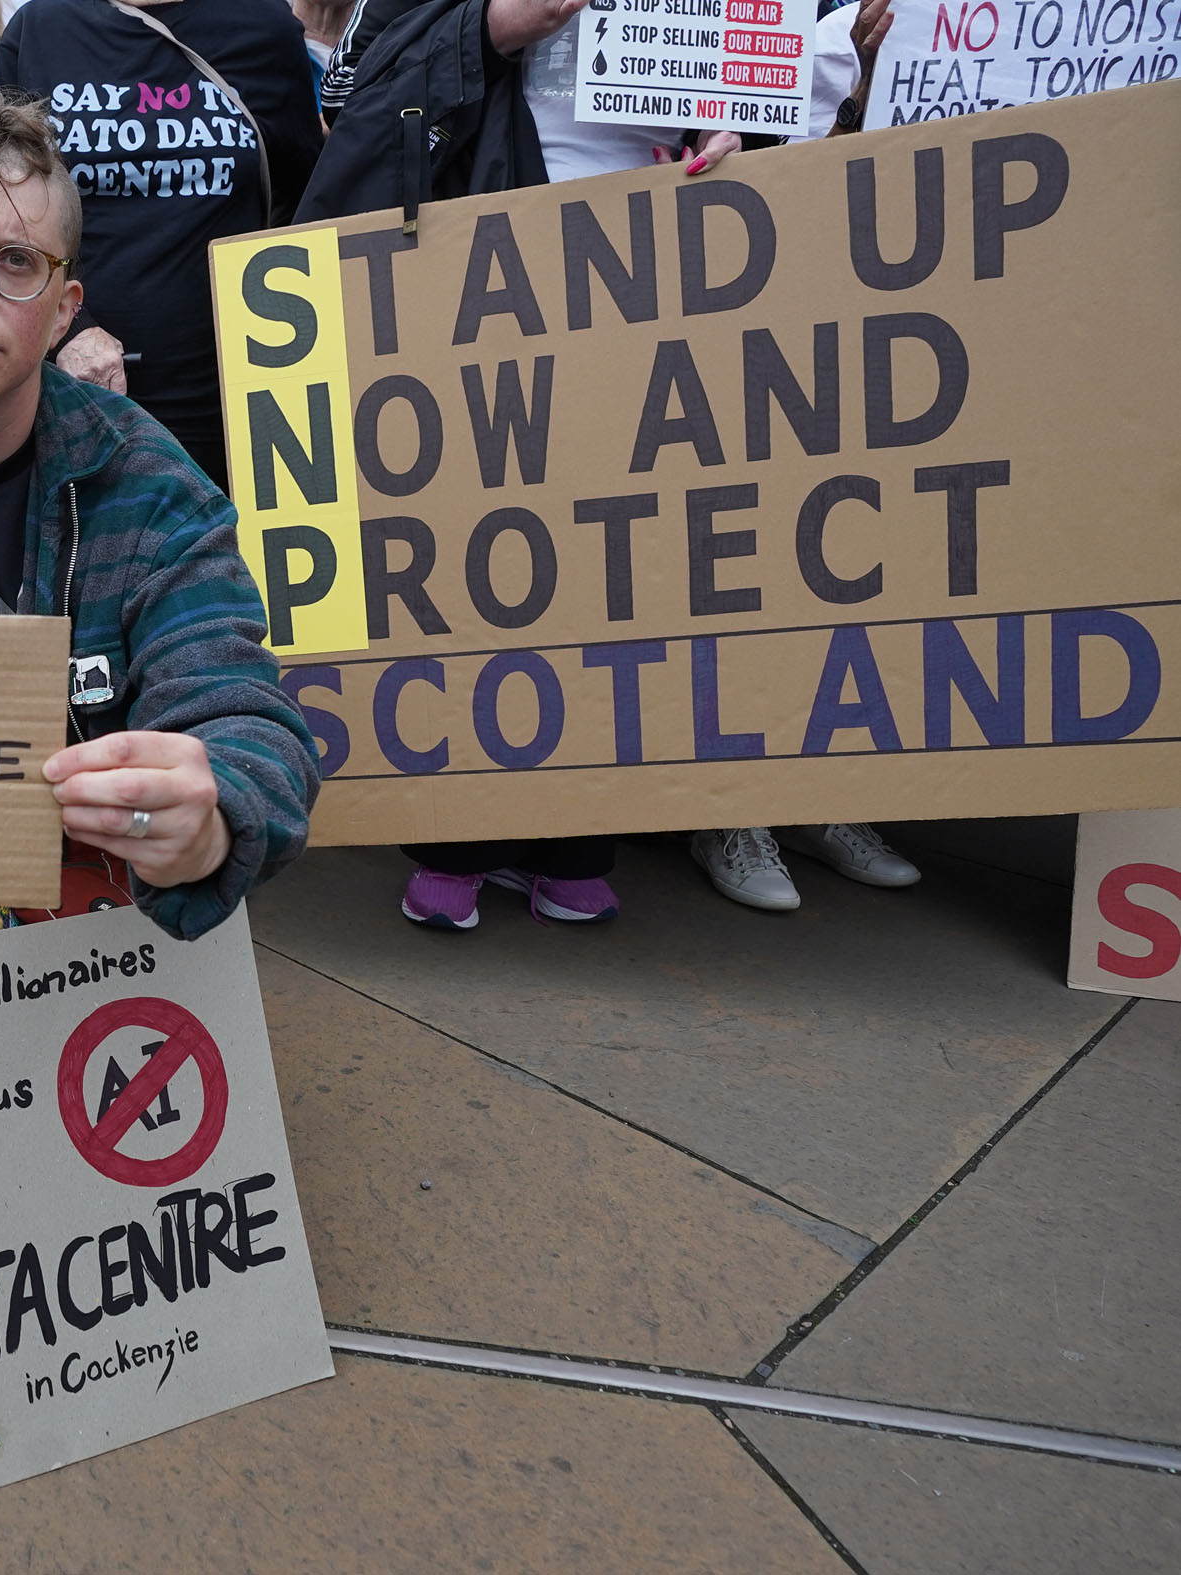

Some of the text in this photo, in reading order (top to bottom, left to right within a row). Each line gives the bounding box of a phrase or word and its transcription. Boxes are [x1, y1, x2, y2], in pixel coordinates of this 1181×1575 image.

[623, 0, 778, 22] STOP SELLING OUR AIR
[932, 1, 999, 52] NO
[1013, 0, 1063, 50] TO
[622, 24, 799, 54] STOP SELLING OUR FUTURE
[620, 56, 793, 86] STOP SELLING OUR WATER
[889, 58, 995, 103] HEAT
[50, 82, 130, 113] SAY
[136, 82, 191, 114] NO
[592, 92, 799, 125] SCOTLAND IS NOT FOR SALE
[68, 156, 235, 198] CENTRE
[242, 132, 1069, 369] STAND UP
[246, 312, 969, 511] NOW AND
[262, 460, 1011, 647] PROTECT
[279, 609, 1162, 778] SCOTLAND
[96, 1040, 181, 1132] AI
[55, 1172, 287, 1333] CENTRE
[25, 1325, 200, 1403] in Cockenzie
